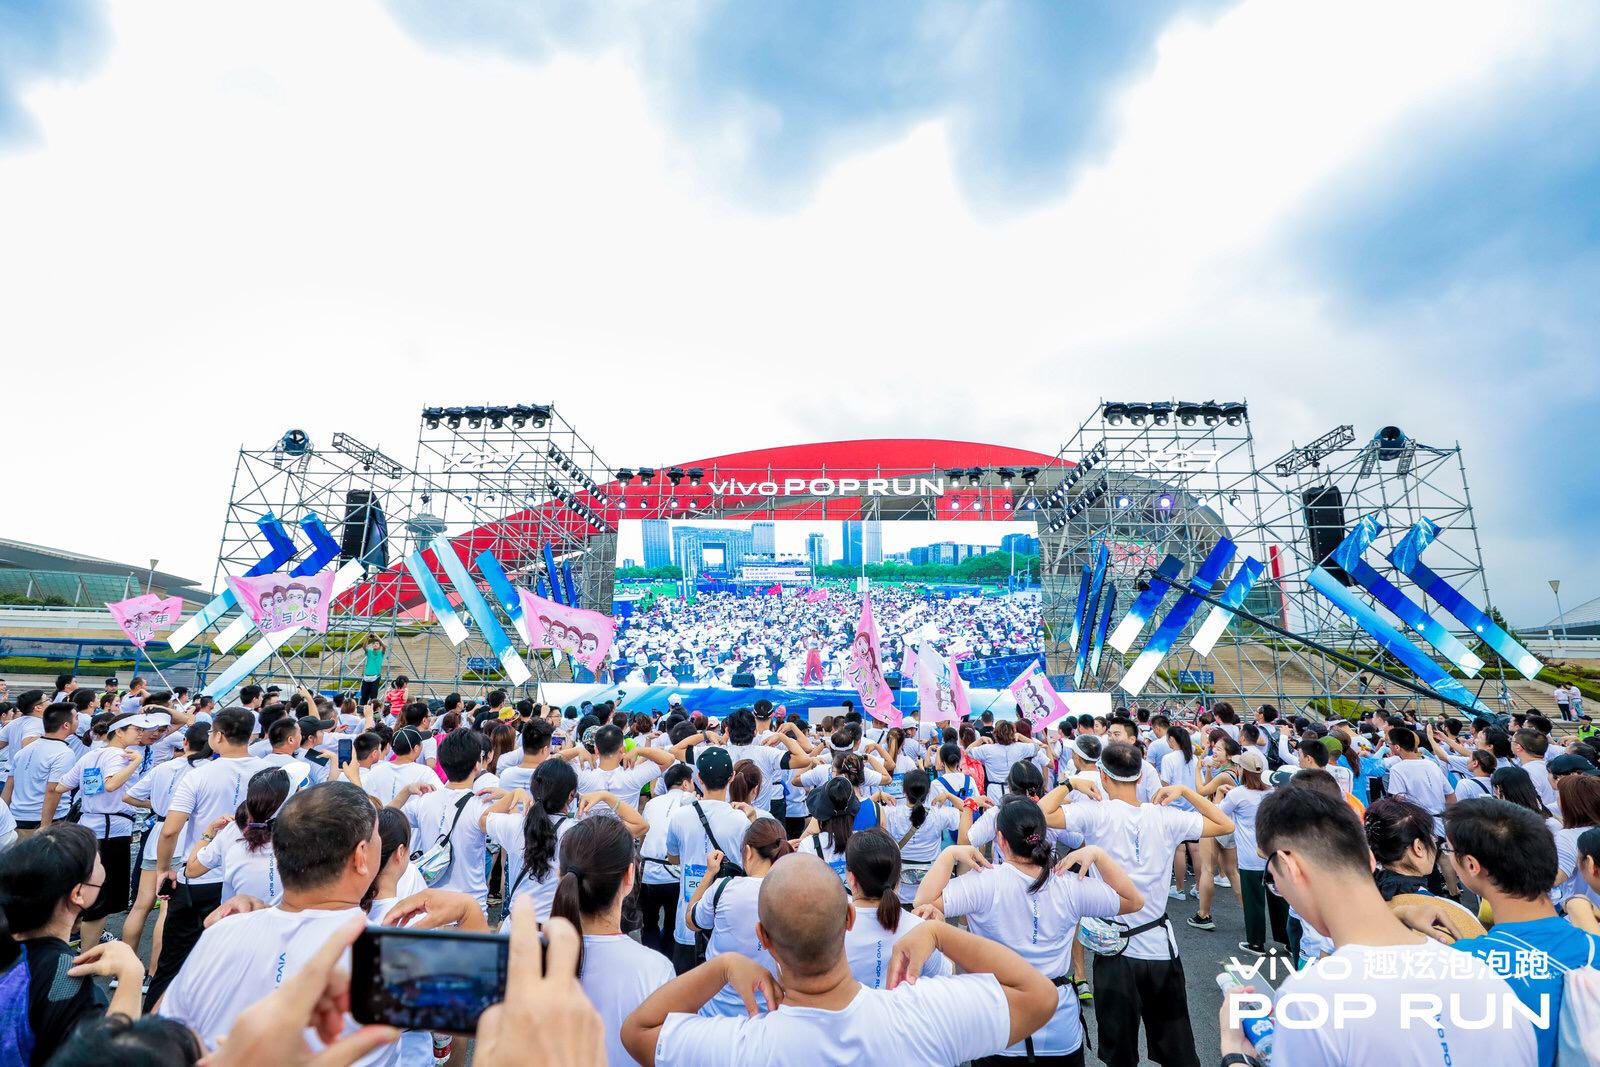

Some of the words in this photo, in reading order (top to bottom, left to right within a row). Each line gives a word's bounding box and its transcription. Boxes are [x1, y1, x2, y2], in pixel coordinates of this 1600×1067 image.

[708, 478, 778, 496] vivo
[784, 478, 861, 496] POP
[867, 478, 944, 496] RUN
[276, 952, 286, 983] VIVO
